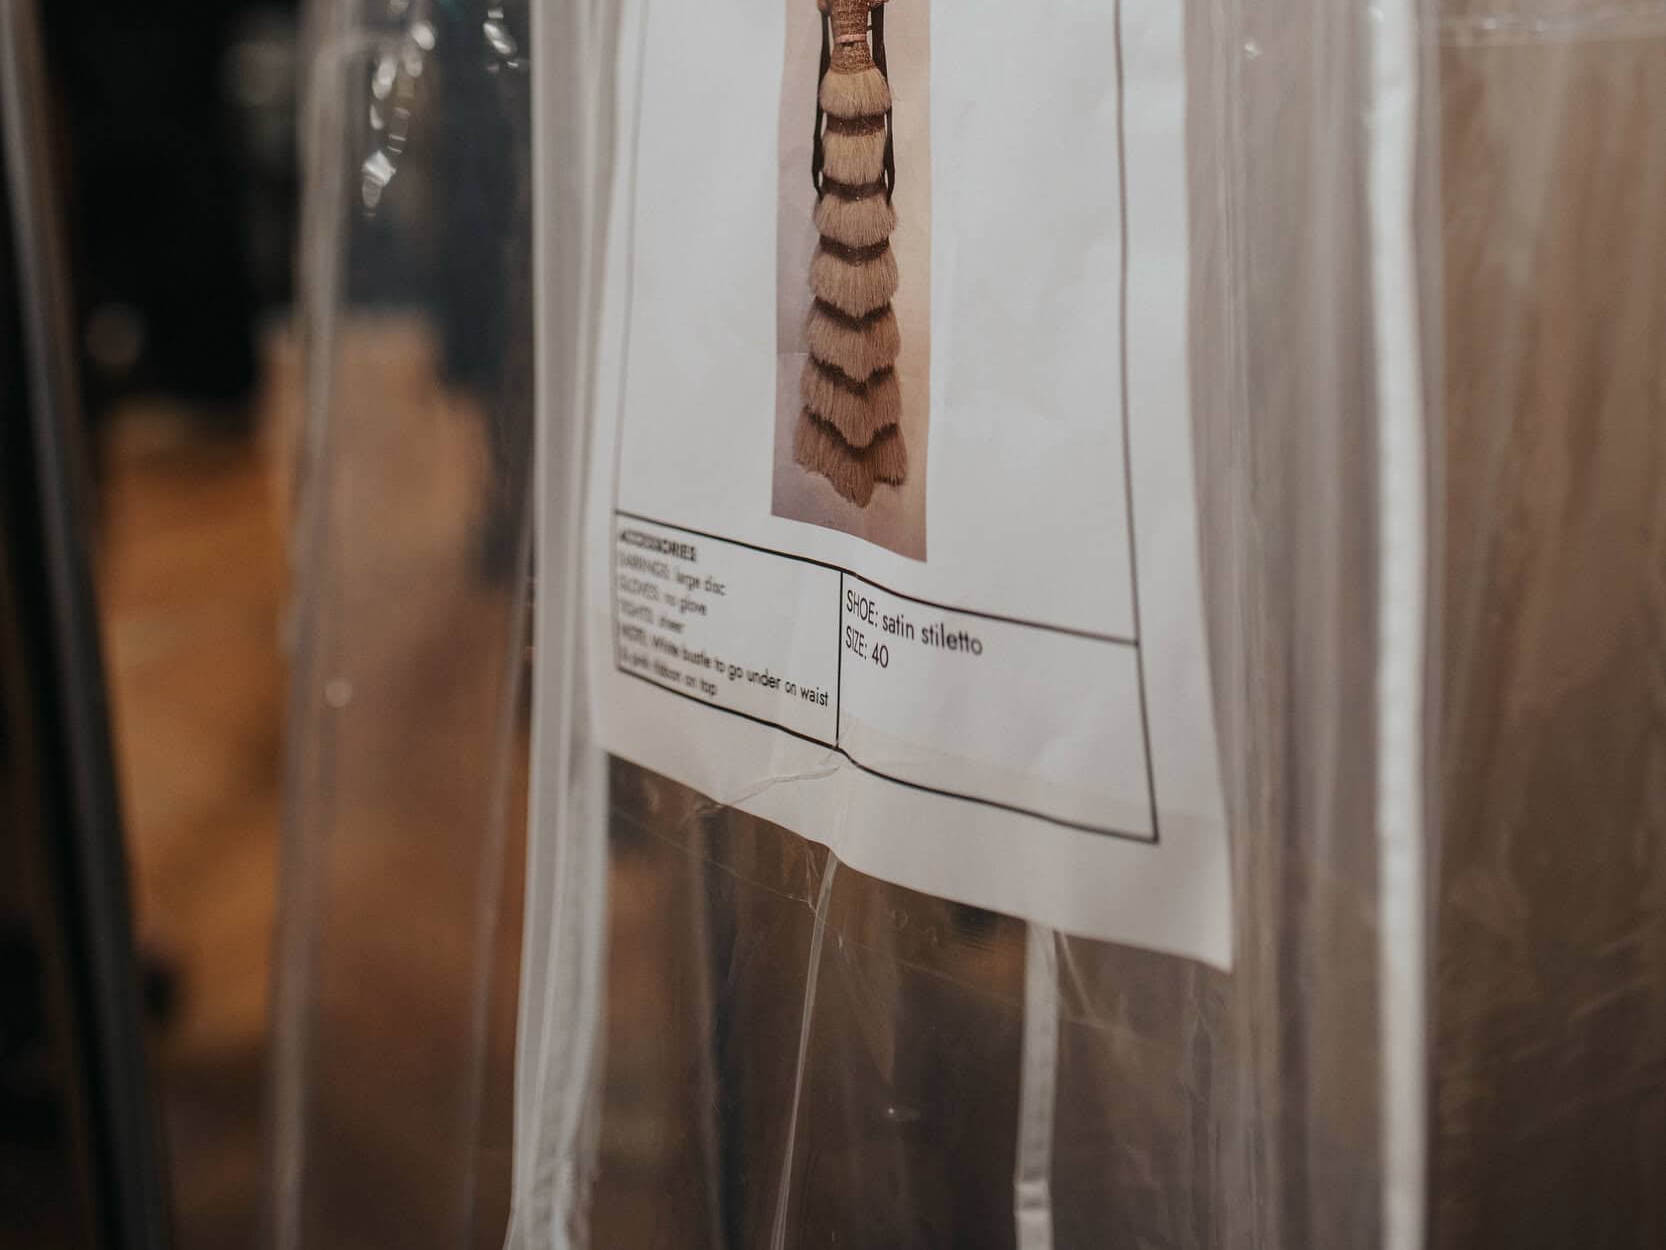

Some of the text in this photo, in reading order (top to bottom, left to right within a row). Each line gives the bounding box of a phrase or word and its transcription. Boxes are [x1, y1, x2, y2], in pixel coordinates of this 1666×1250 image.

[674, 568, 702, 592] large
[704, 574, 726, 597] disc
[845, 625, 889, 669] SIZE: 40
[846, 589, 984, 657] SHOE: satin stiletto
[714, 655, 726, 674] to
[727, 662, 744, 683] go
[746, 667, 781, 692] under
[784, 681, 798, 697] on
[800, 686, 829, 708] waist
